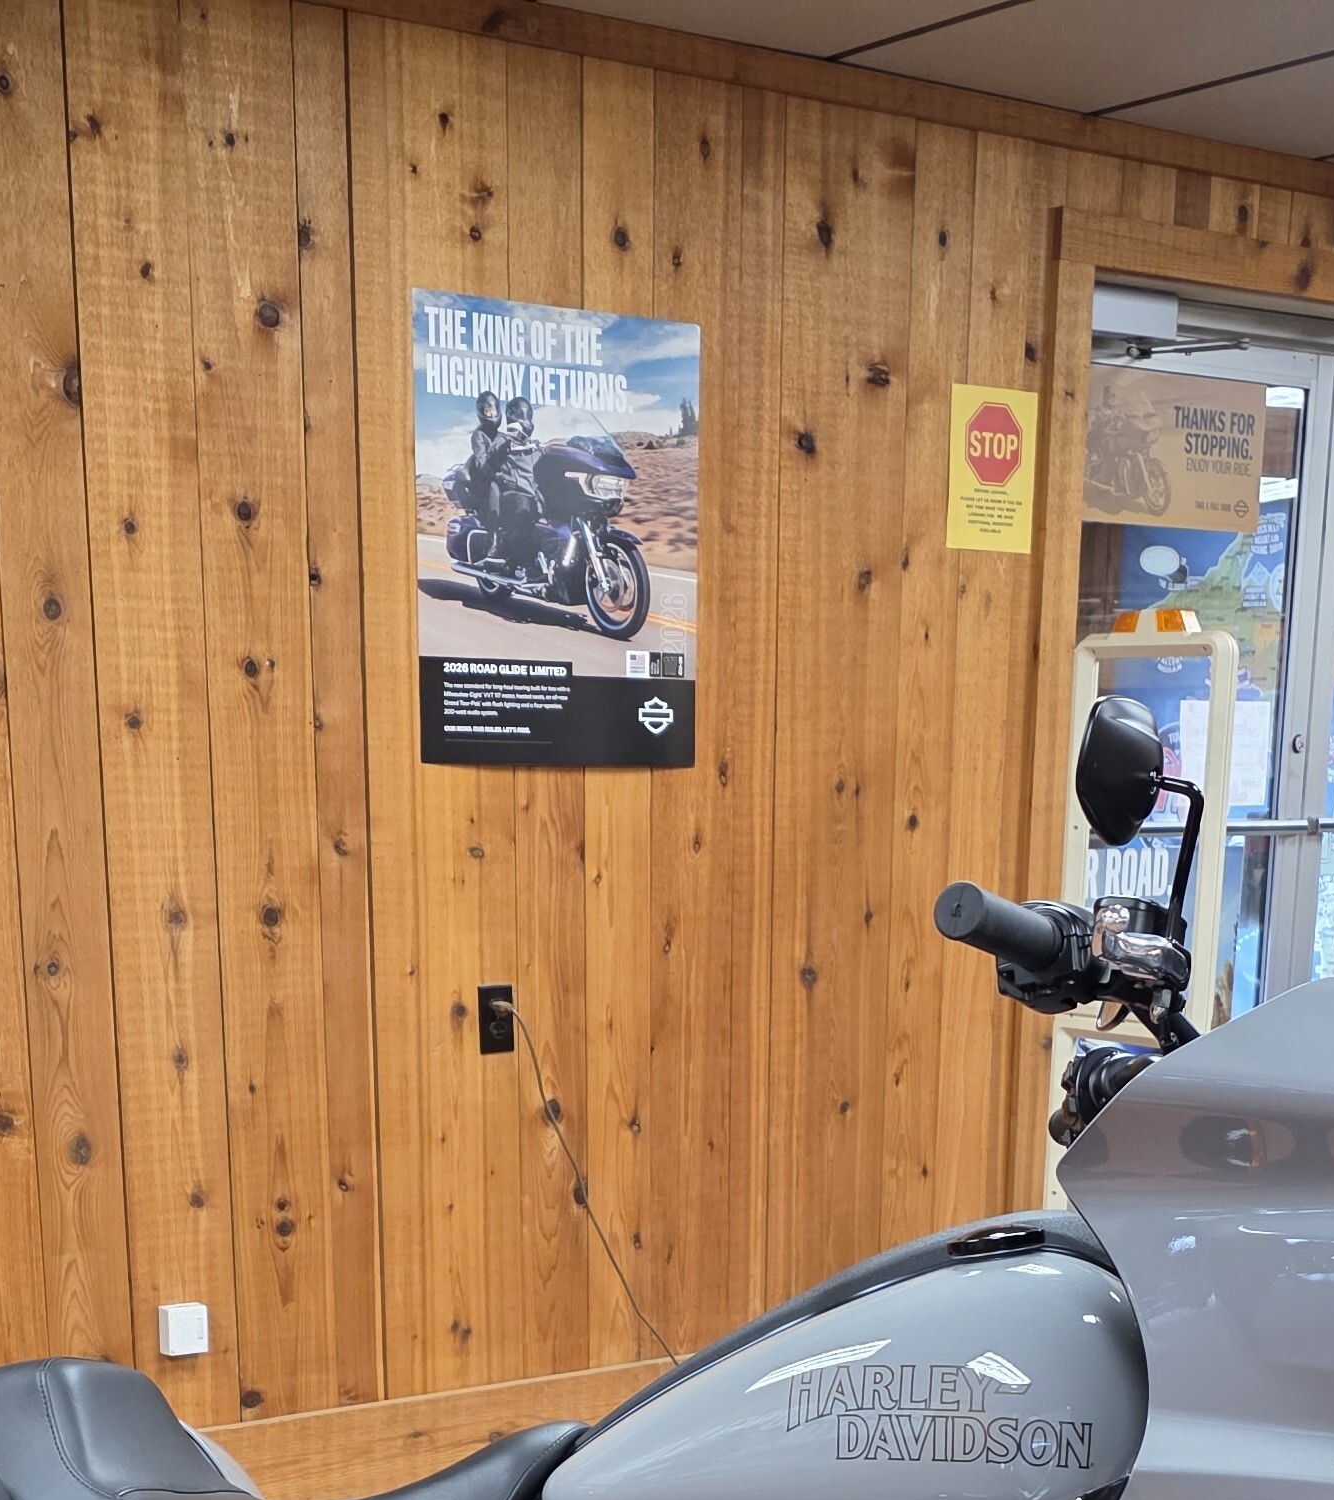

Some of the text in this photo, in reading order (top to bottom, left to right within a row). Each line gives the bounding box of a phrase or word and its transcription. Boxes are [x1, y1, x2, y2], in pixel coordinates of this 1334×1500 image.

[424, 305, 603, 366] THE KING OF THE
[426, 353, 634, 413] HIGHWAY RETURNS.
[1174, 405, 1255, 436] THANKS FOR
[970, 430, 1018, 460] STOP
[1184, 432, 1253, 460] STOPPING.
[1186, 457, 1210, 473] ENJOY
[1211, 459, 1232, 475] YOUR
[443, 662, 567, 677] 2026 ROAD GLIDE LIMITED
[1105, 848, 1172, 897] ROAD.
[836, 1414, 1092, 1469] DAVIDSON
